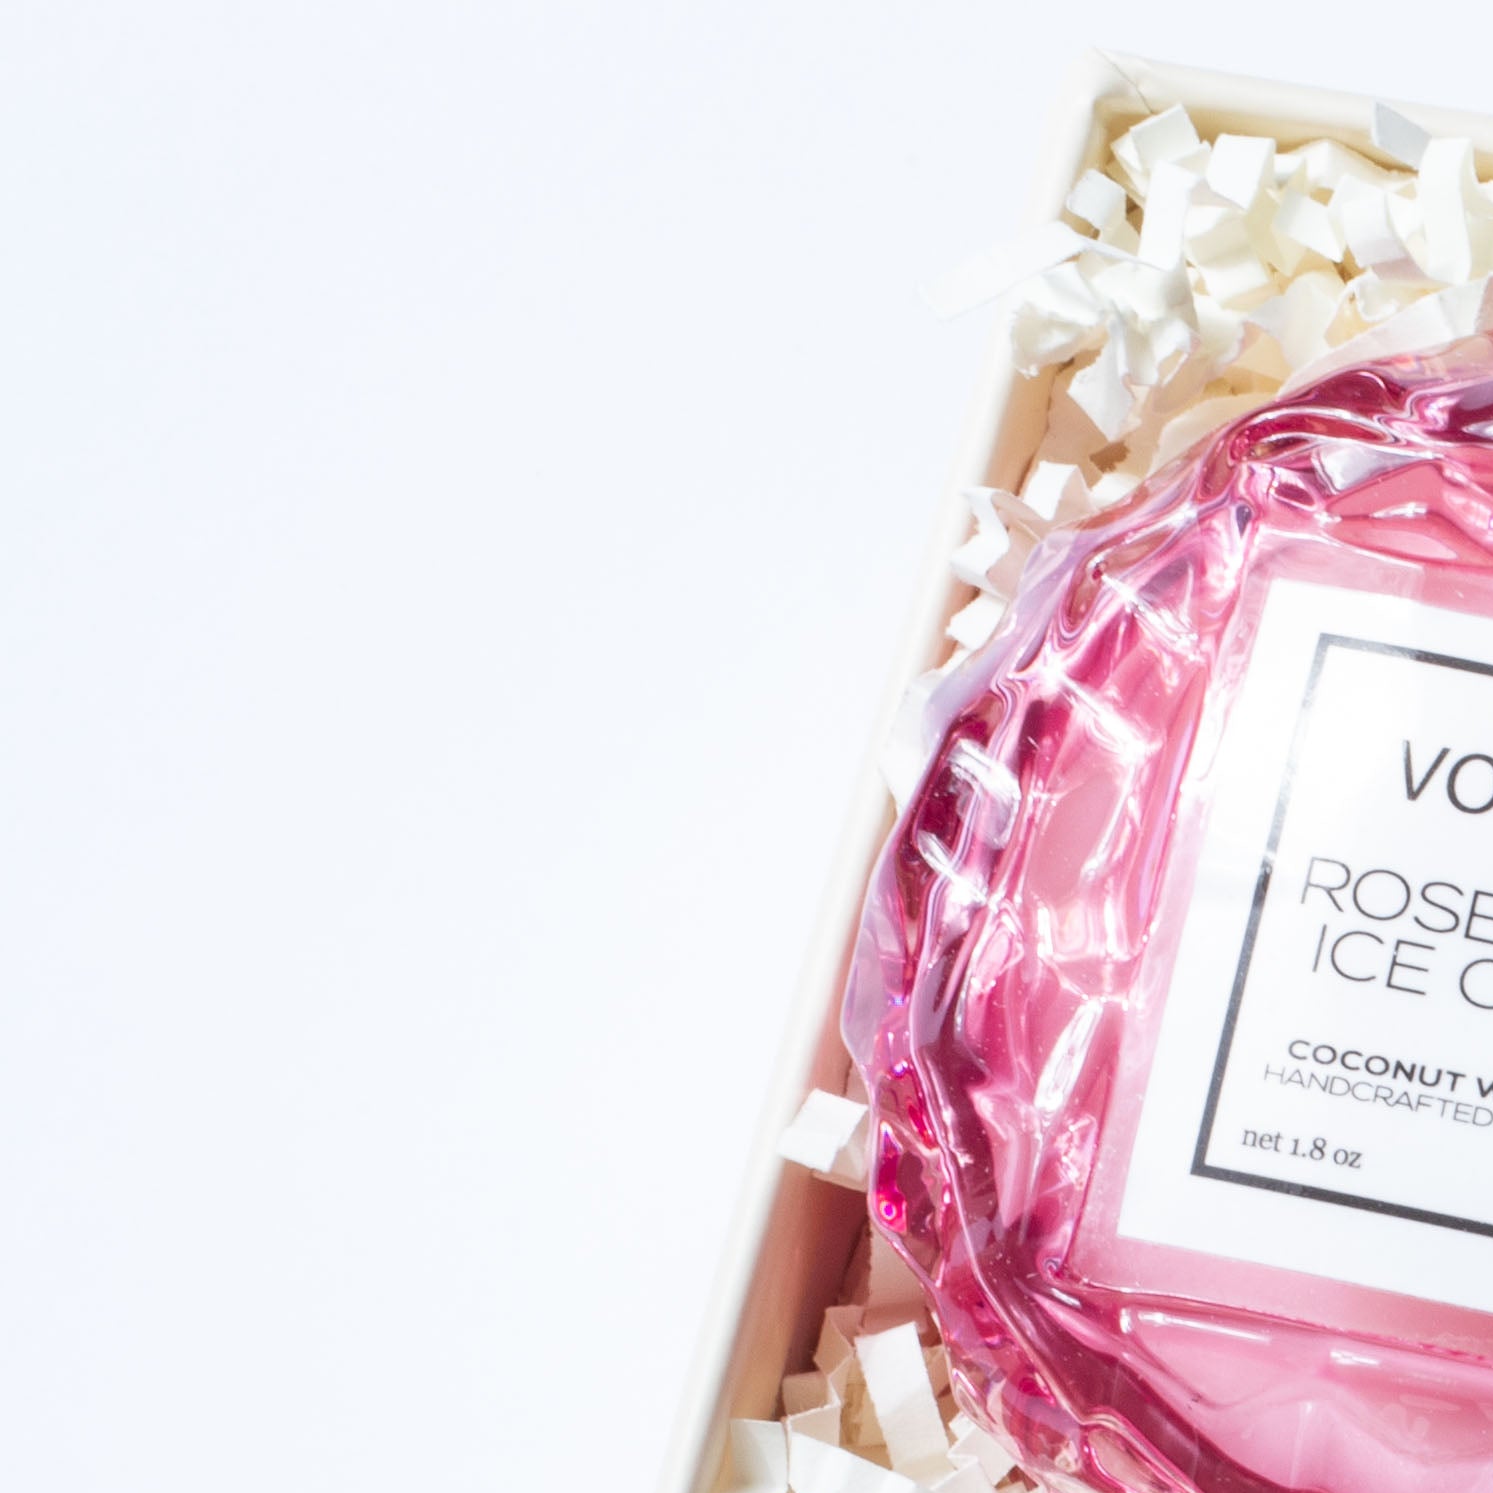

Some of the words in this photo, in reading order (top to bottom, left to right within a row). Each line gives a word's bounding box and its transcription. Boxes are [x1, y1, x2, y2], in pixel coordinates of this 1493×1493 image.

[1313, 924, 1431, 997] ICE
[1288, 1039, 1466, 1093] COCONUT
[1242, 1126, 1283, 1155] net
[1291, 1136, 1327, 1162] 1.8
[1333, 1148, 1362, 1169] oz
